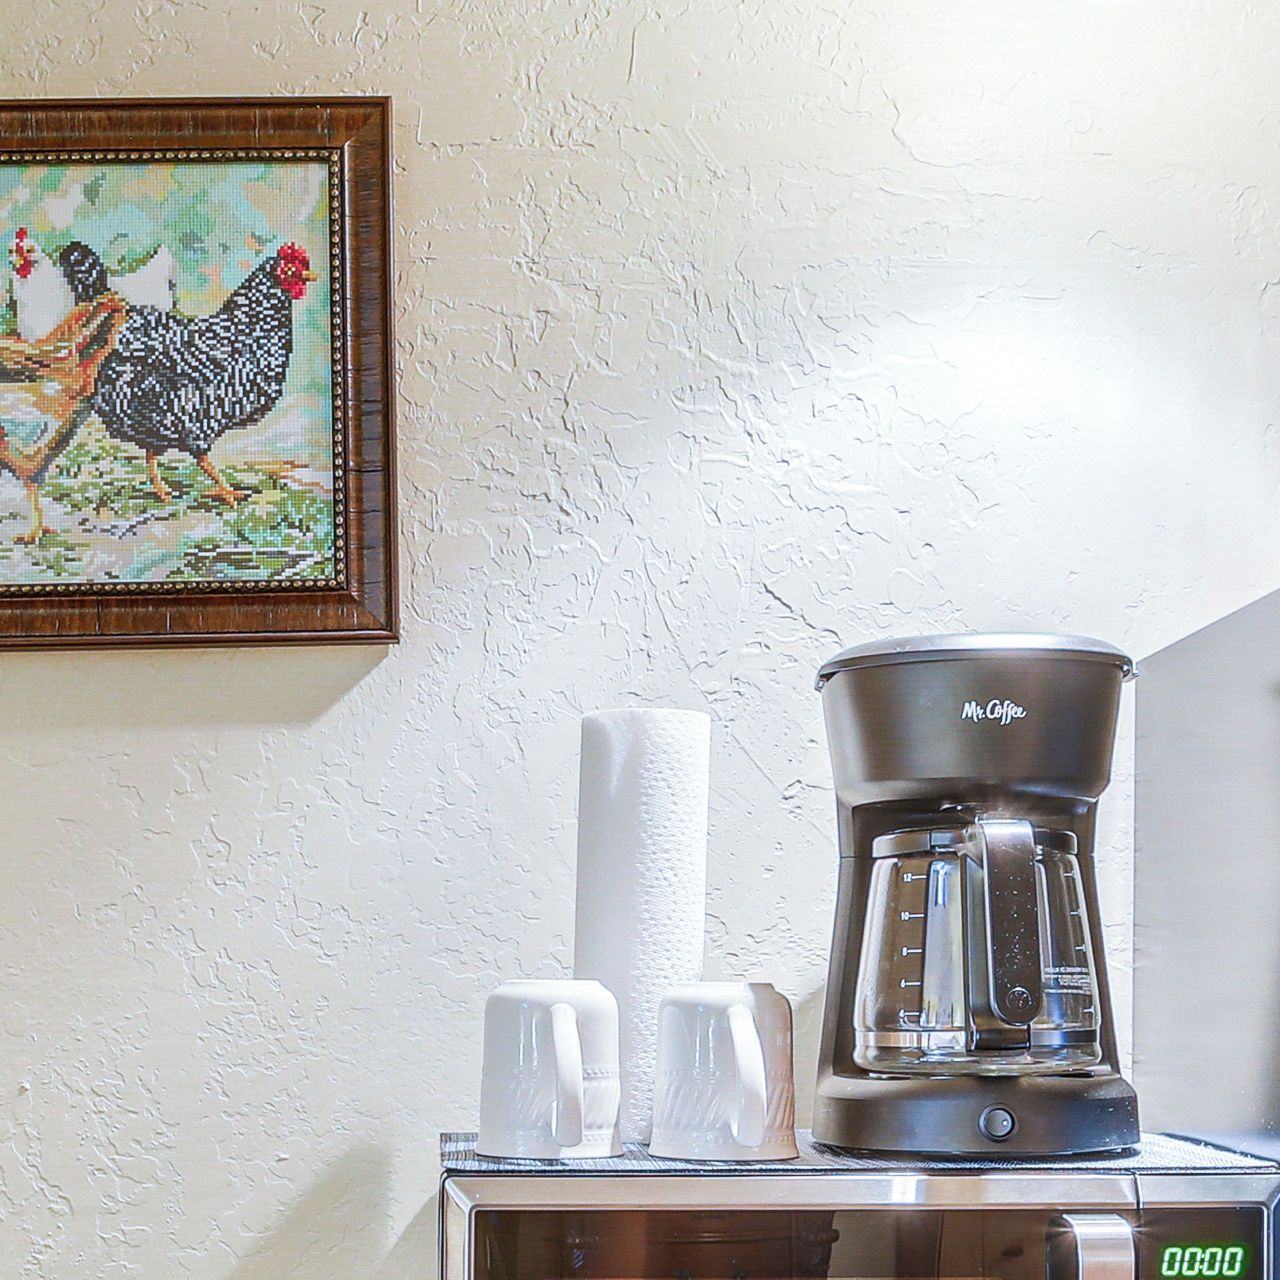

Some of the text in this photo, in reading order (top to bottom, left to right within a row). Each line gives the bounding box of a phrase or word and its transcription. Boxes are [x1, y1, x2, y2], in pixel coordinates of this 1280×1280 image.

[962, 700, 1027, 725] Mr. Coffee
[1161, 1247, 1244, 1276] 00:00
